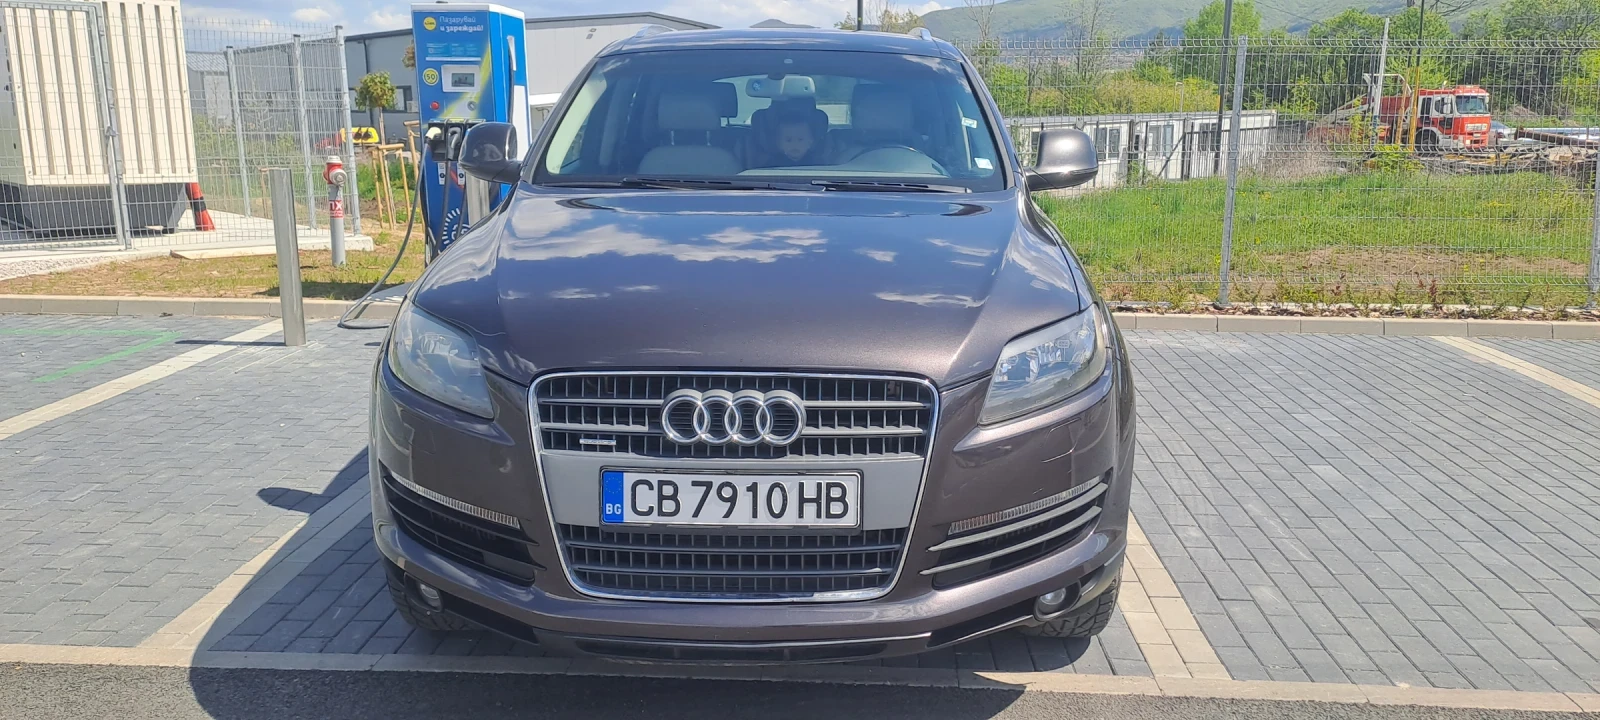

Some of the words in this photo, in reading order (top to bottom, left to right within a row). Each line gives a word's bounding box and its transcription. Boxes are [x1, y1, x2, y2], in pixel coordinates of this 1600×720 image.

[605, 503, 622, 515] BG
[630, 479, 681, 517] CB
[691, 481, 788, 519] 7910
[798, 481, 849, 519] HB
